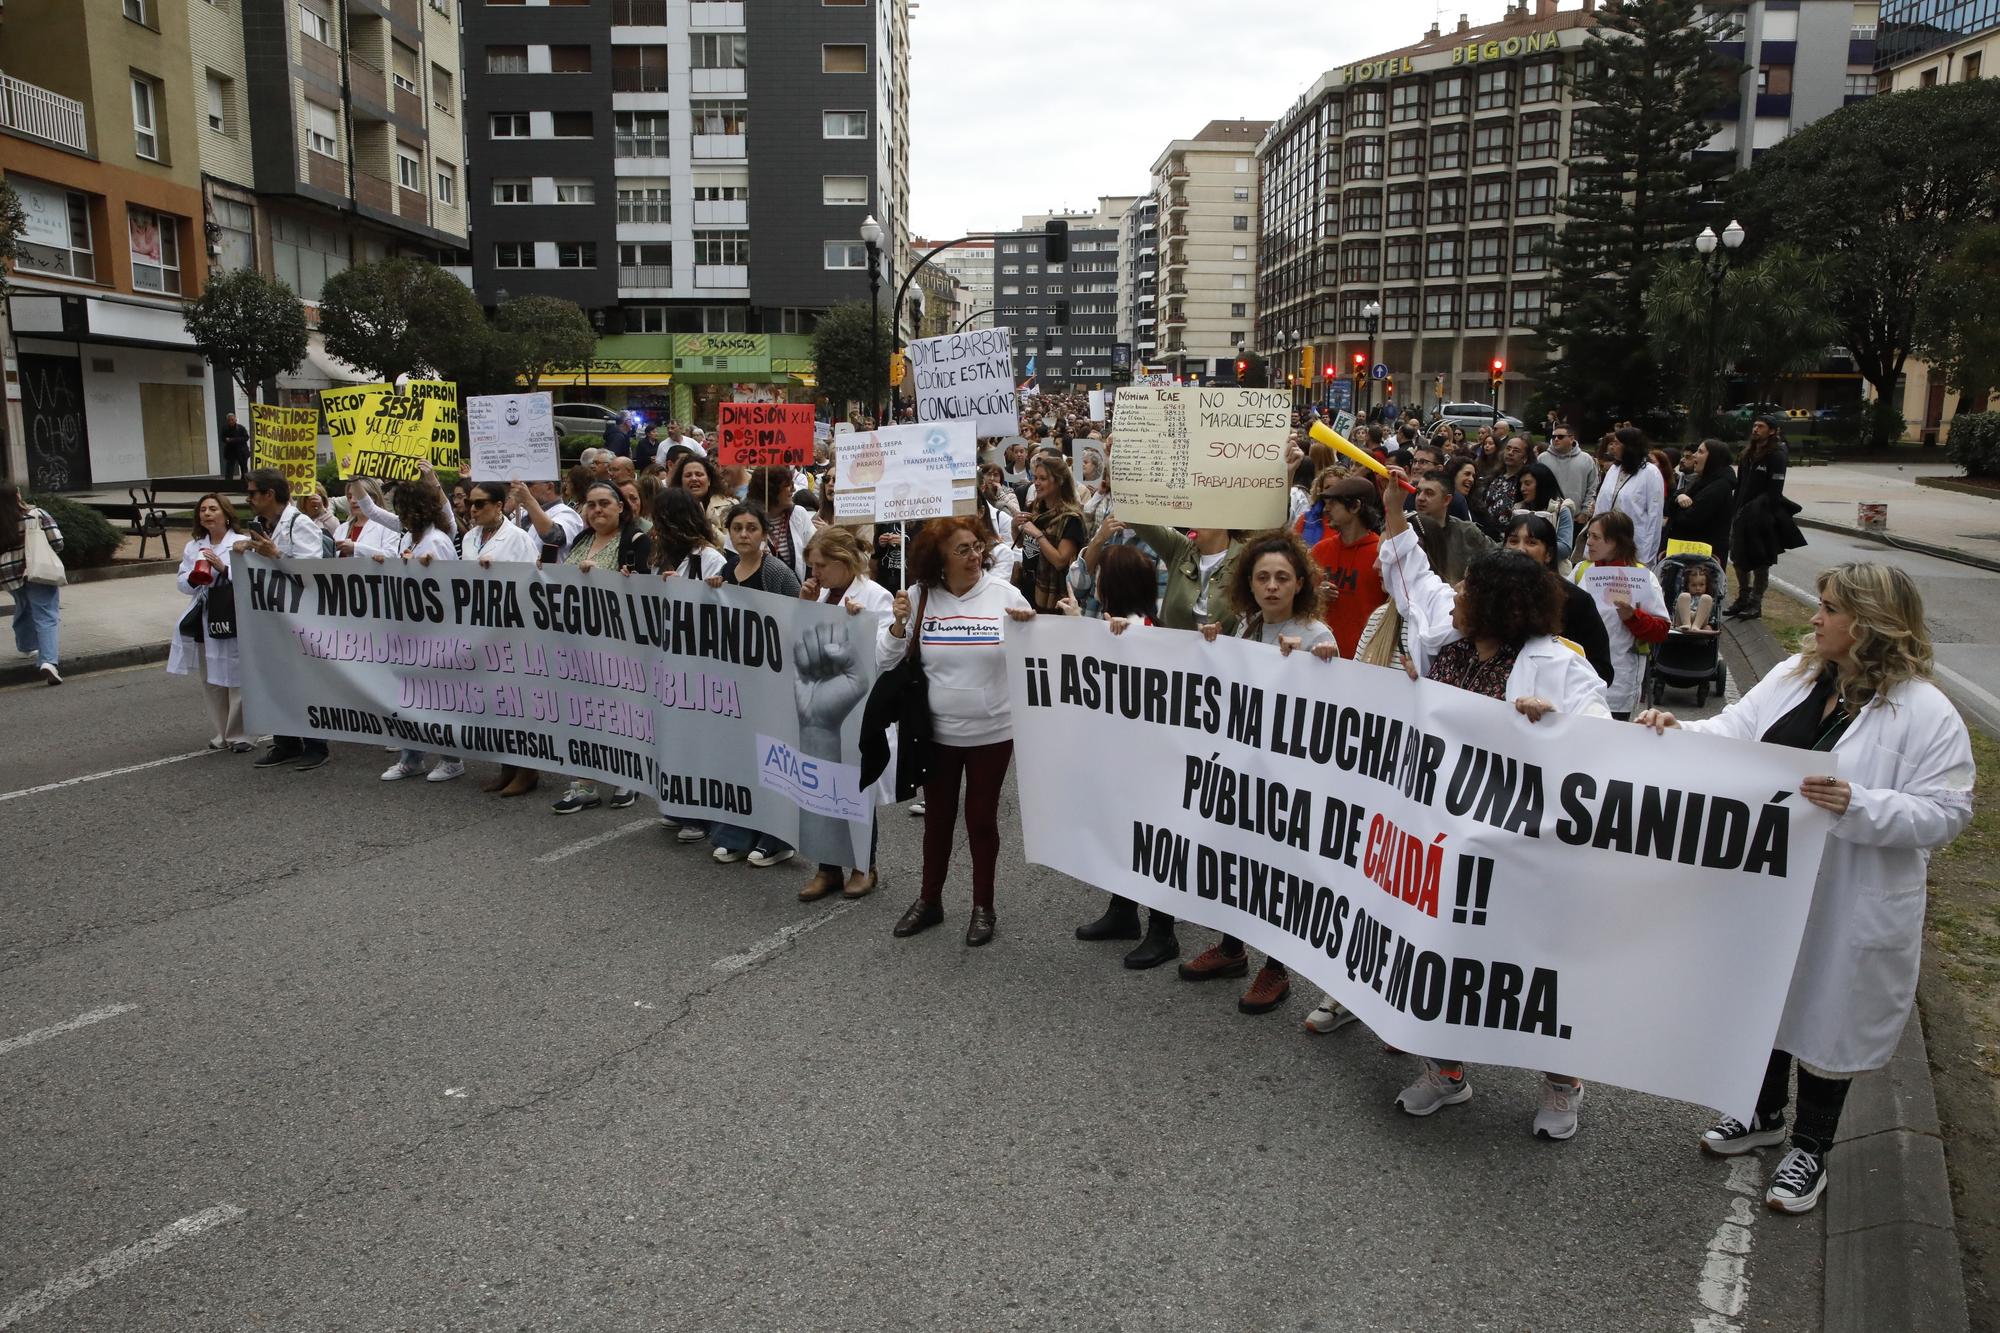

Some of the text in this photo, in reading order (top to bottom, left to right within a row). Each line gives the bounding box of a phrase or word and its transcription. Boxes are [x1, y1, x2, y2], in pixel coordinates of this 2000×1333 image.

[1342, 30, 1560, 84] HOTEL BEGOÑA
[707, 338, 756, 349] PLANETA
[912, 340, 949, 366] DIME,
[917, 355, 1011, 390] ¿DÓNDE ESTÁ MI
[919, 389, 1015, 421] CONCILIACIÓN?
[1118, 389, 1180, 401] NÓMINA TCAE
[1199, 390, 1291, 409] NO SOMOS
[252, 405, 317, 425] SOMETIDOS
[375, 396, 425, 421] SESPA
[723, 405, 786, 425] DIMISIÓN
[801, 411, 811, 424] LA
[365, 416, 404, 436] ya no
[1200, 412, 1287, 428] MARQUESES
[255, 421, 315, 442] ENGAÑADOS
[255, 440, 316, 460] SILENCIADOS
[371, 433, 429, 457] CREO TUS
[884, 440, 903, 448] SESPA
[1206, 441, 1281, 461] SOMOS
[355, 452, 422, 480] MENTIRAS
[903, 456, 953, 465] TRANSPARENCIA
[945, 461, 975, 469] GERENCIA
[1191, 472, 1285, 489] TRABAJADORES
[884, 496, 942, 508] CONCILIACIÓN
[883, 507, 941, 519] SIN COACCIÓN
[248, 567, 783, 673] HAY MOTIVOS PARA SEGUIR LUCHANDO
[922, 621, 999, 635] Champion
[480, 640, 516, 674] DE
[523, 641, 550, 678] LA
[555, 647, 647, 695] SANIDAD
[495, 679, 526, 719] EN
[532, 687, 560, 724] SU
[568, 693, 657, 744] DEFENSA
[307, 704, 384, 736] SANIDAD
[385, 712, 456, 750] PÚBLICA
[460, 724, 564, 767] UNIVERSAL,
[568, 738, 644, 781] GRATUITA
[646, 756, 653, 785] Y
[660, 771, 753, 816] CALIDAD
[1025, 654, 1794, 879] ¡¡ ASTURIES NA LLUCHA POR UNA SANIDÁ
[1183, 751, 1496, 927] PÚBLICA DE CALIDÁ !!
[1132, 820, 1573, 1041] NON DEIXEMOS QUE MORRA.
